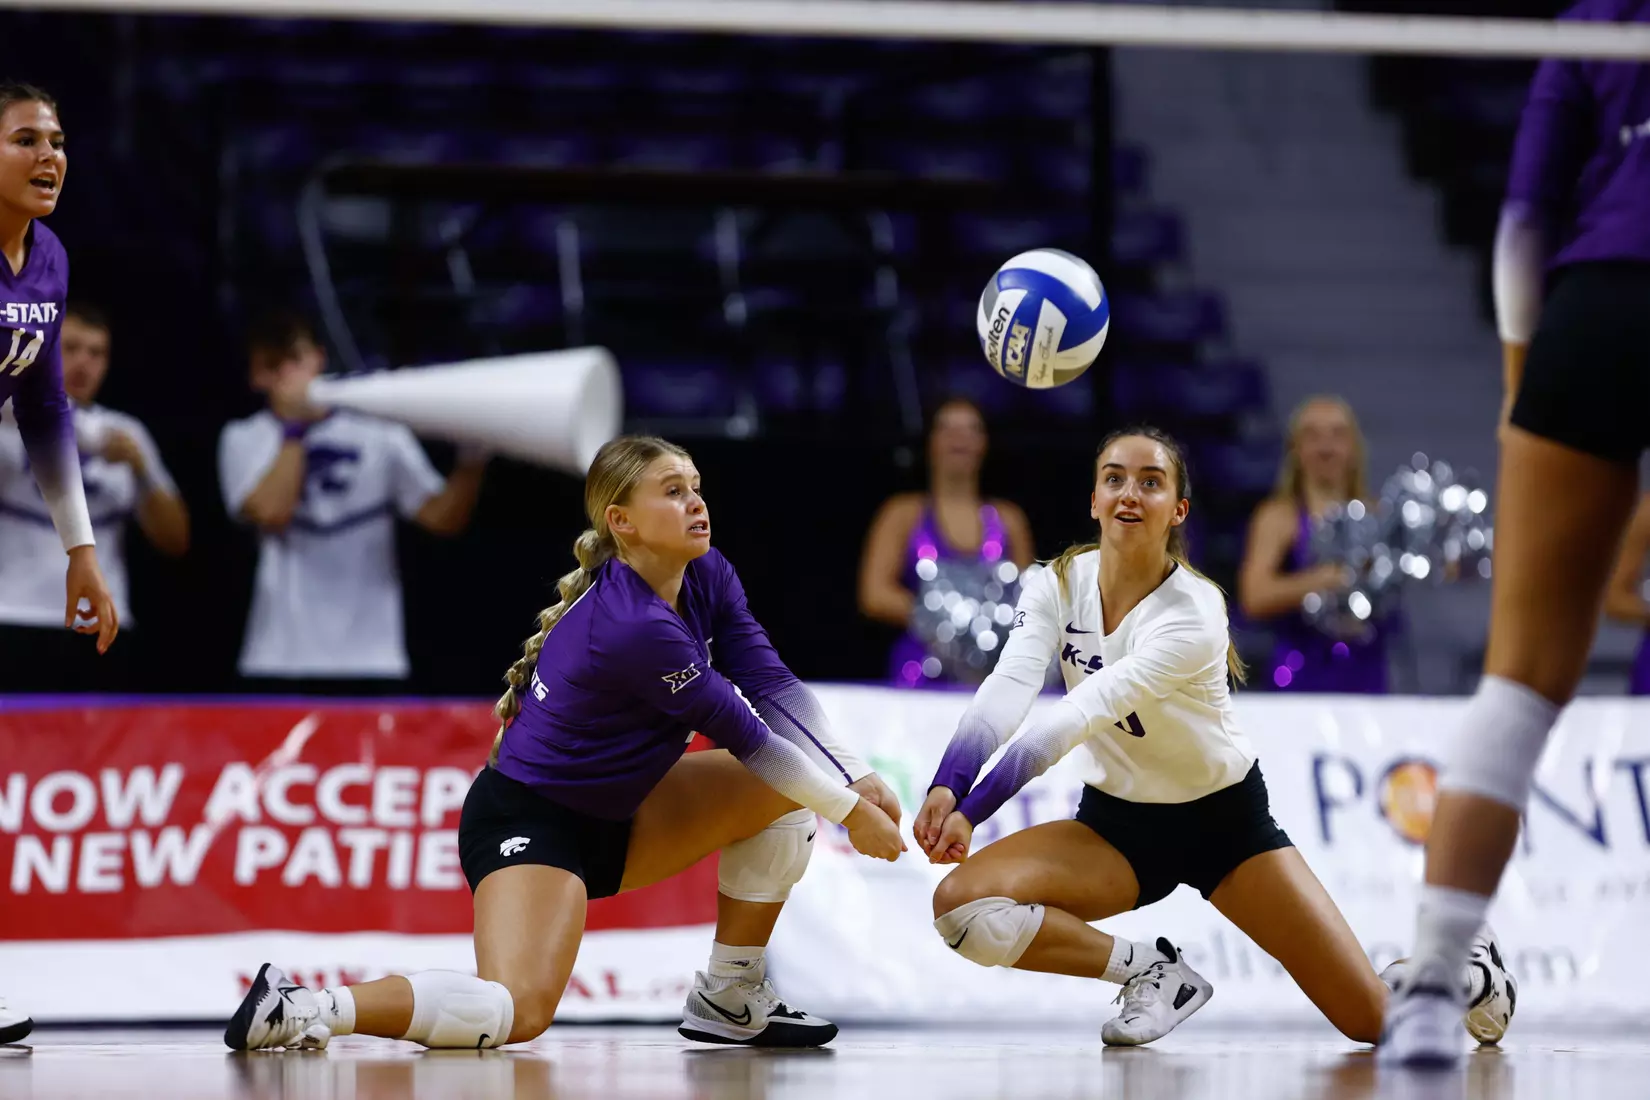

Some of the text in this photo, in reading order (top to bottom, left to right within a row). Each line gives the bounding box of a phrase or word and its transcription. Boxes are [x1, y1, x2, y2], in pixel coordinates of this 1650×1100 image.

[0, 327, 44, 376] 14
[1004, 323, 1032, 377] NCAA
[204, 762, 483, 828] ACCEP
[1311, 752, 1650, 856] PONT
[10, 823, 214, 894] NEW
